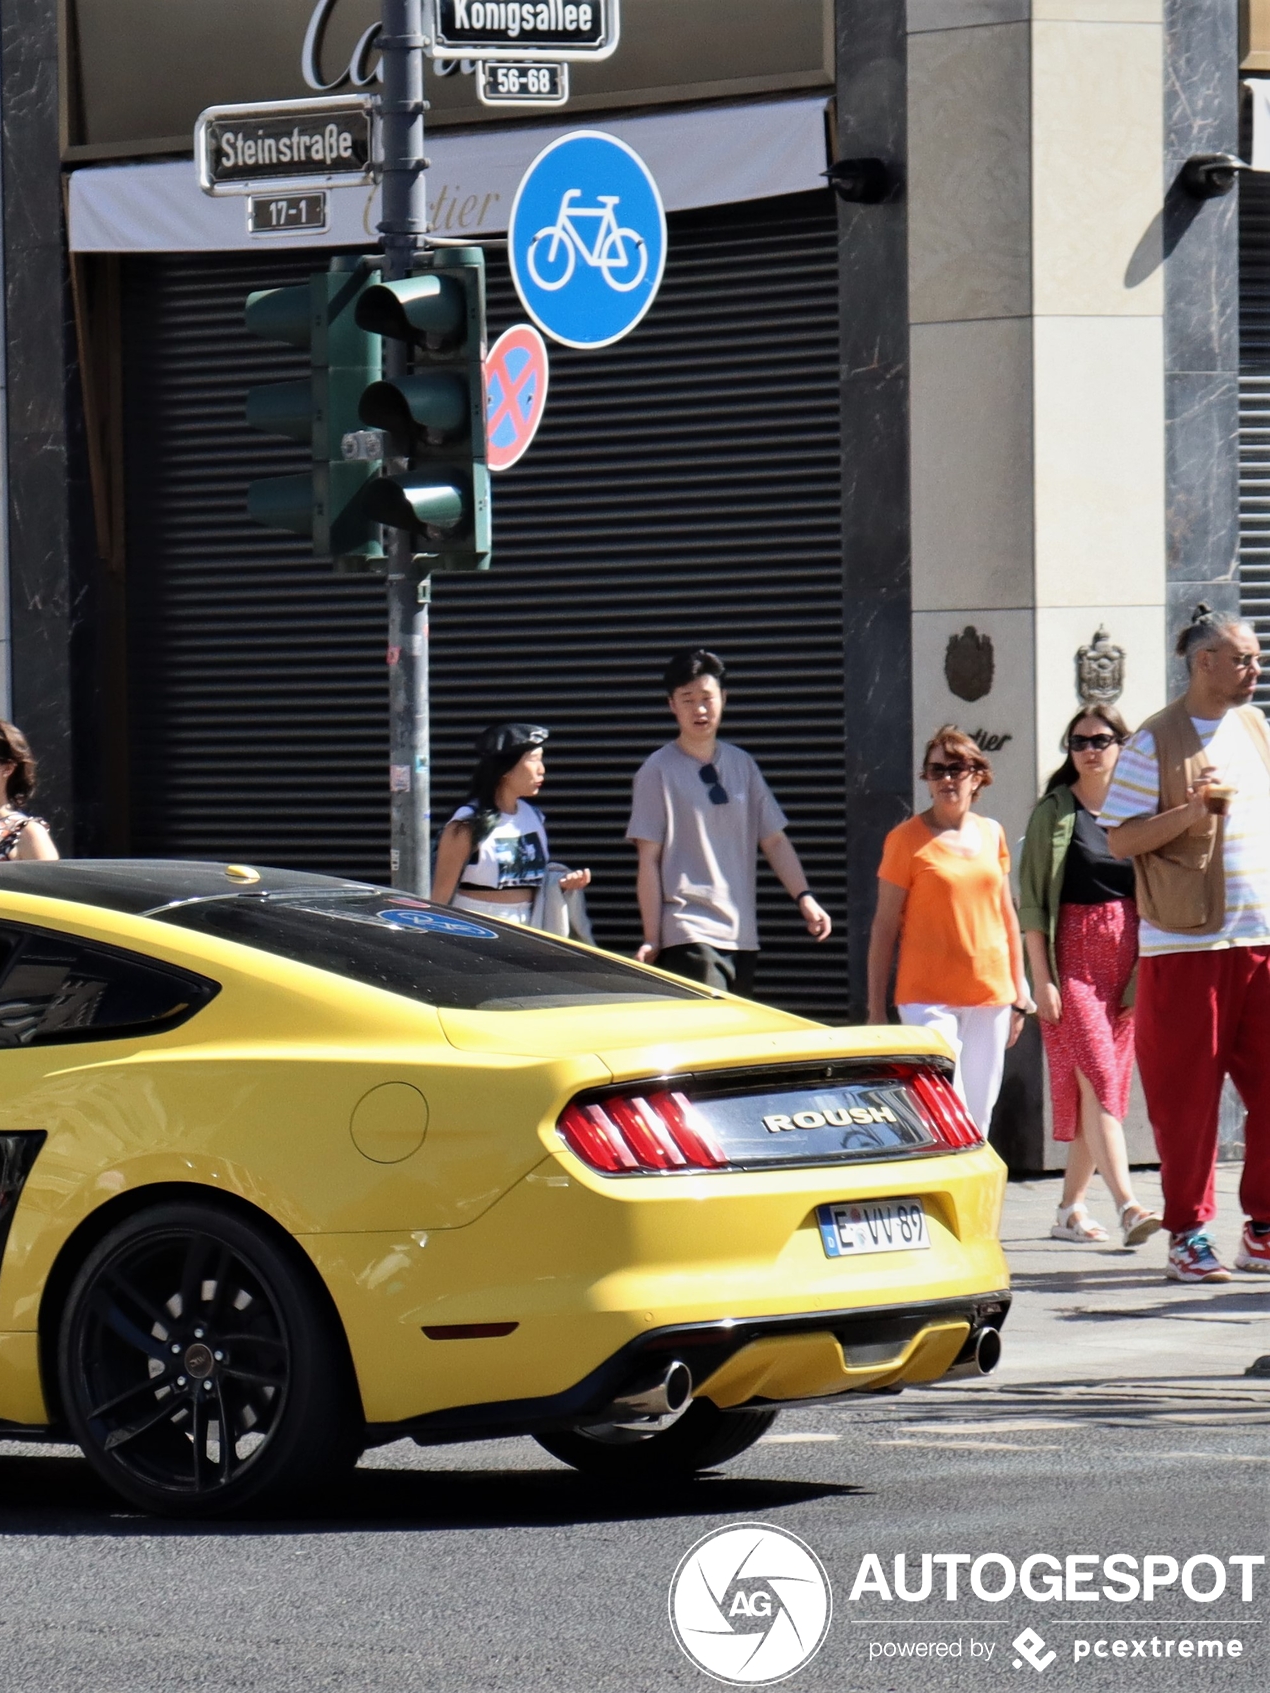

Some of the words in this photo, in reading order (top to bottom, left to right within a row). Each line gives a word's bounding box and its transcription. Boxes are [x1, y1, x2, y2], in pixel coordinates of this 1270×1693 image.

[496, 68, 551, 93] 56-68
[221, 123, 353, 168] Steinstraße
[269, 200, 307, 226] 17-1
[762, 1106, 898, 1133] ROUSH
